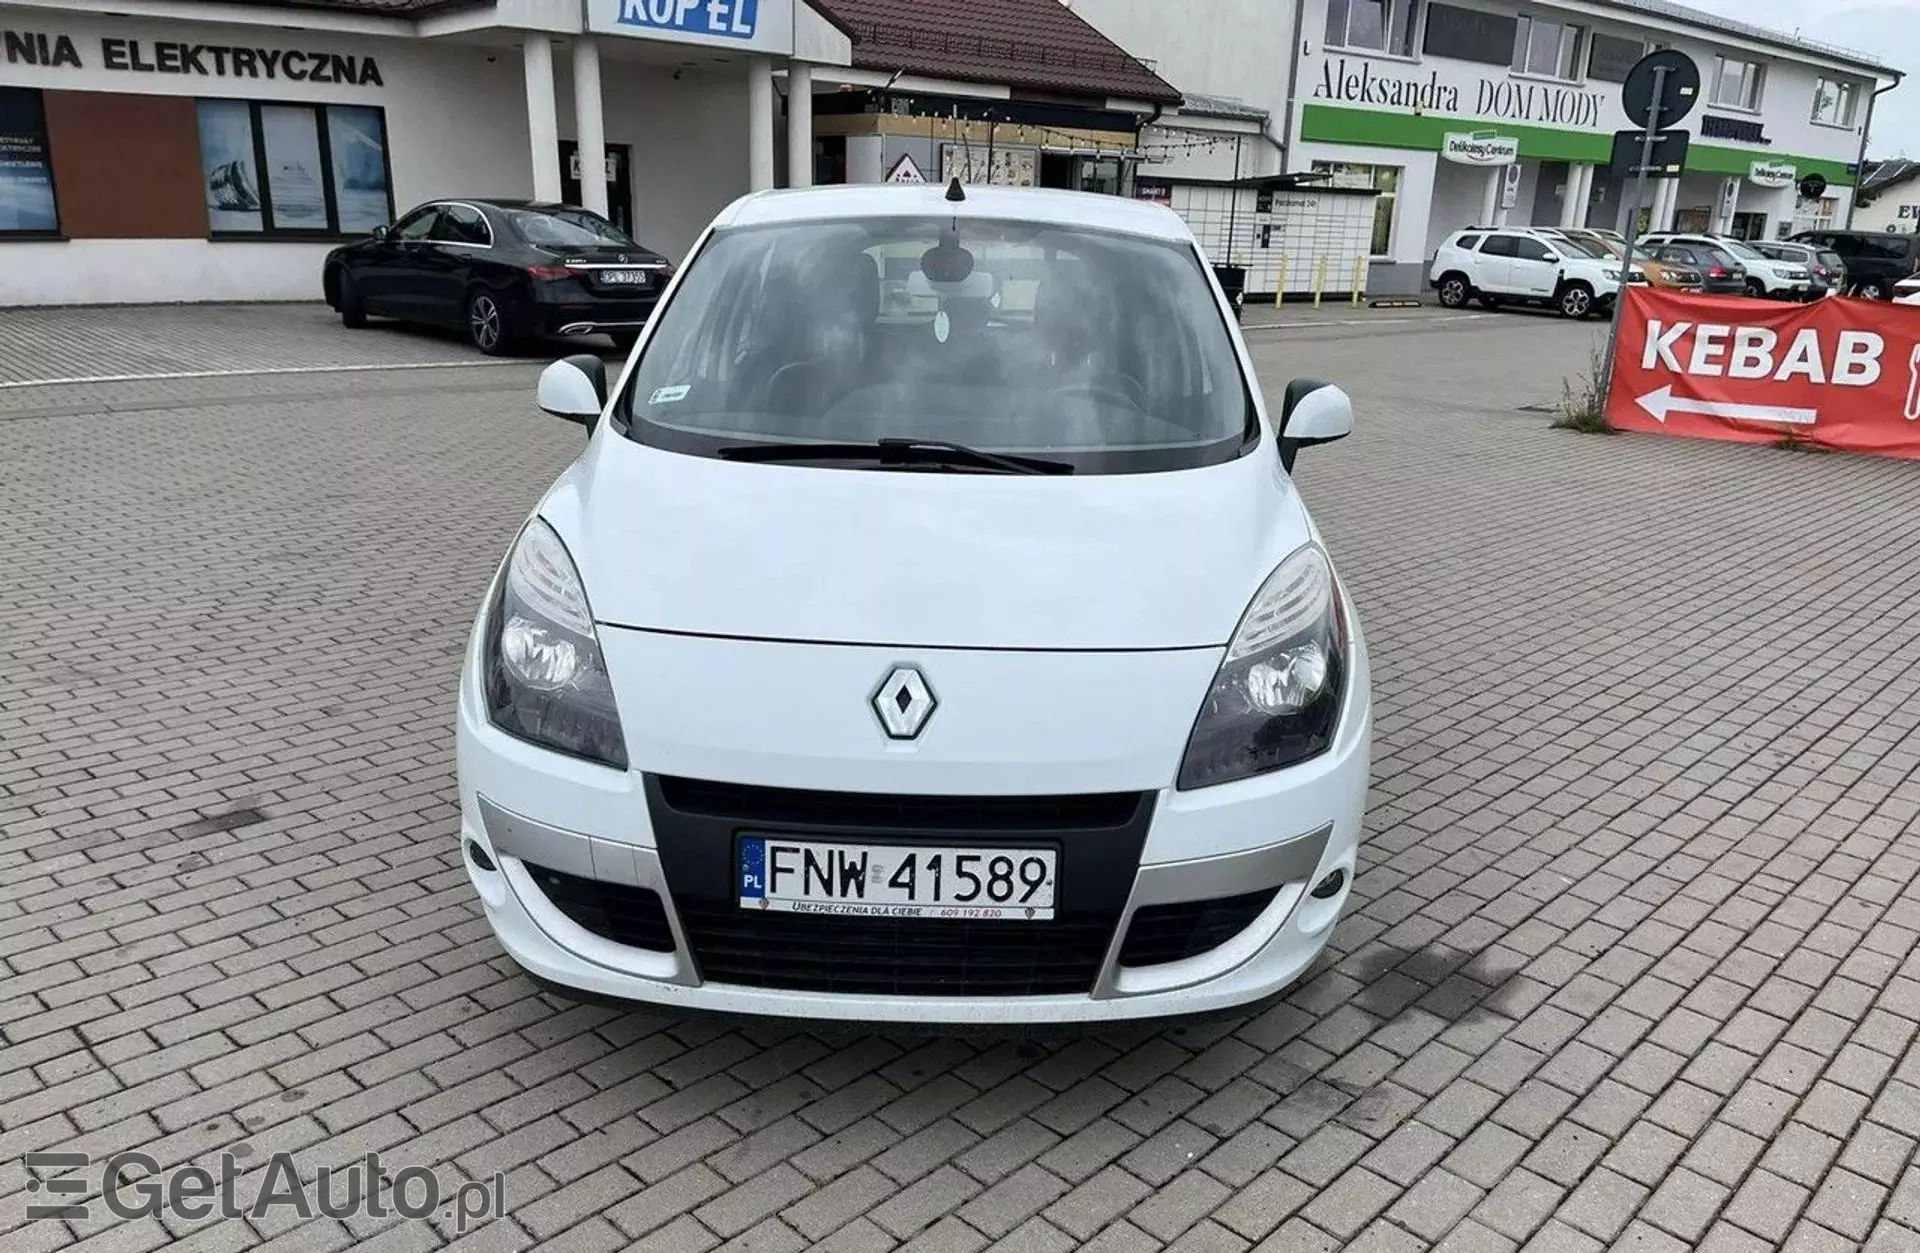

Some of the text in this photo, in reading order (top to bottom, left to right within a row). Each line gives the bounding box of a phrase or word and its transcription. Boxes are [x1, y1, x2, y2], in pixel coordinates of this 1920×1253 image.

[2, 30, 385, 87] NIA ELEKTRYCZNA
[1313, 58, 1607, 128] Aleksandra DOM MODY
[1641, 319, 1885, 386] KEBAB
[743, 874, 762, 889] PL
[769, 845, 1048, 904] FNW 41589
[870, 906, 890, 917] DLA
[940, 908, 961, 918] 609
[962, 909, 980, 918] 192
[983, 909, 1003, 918] 820
